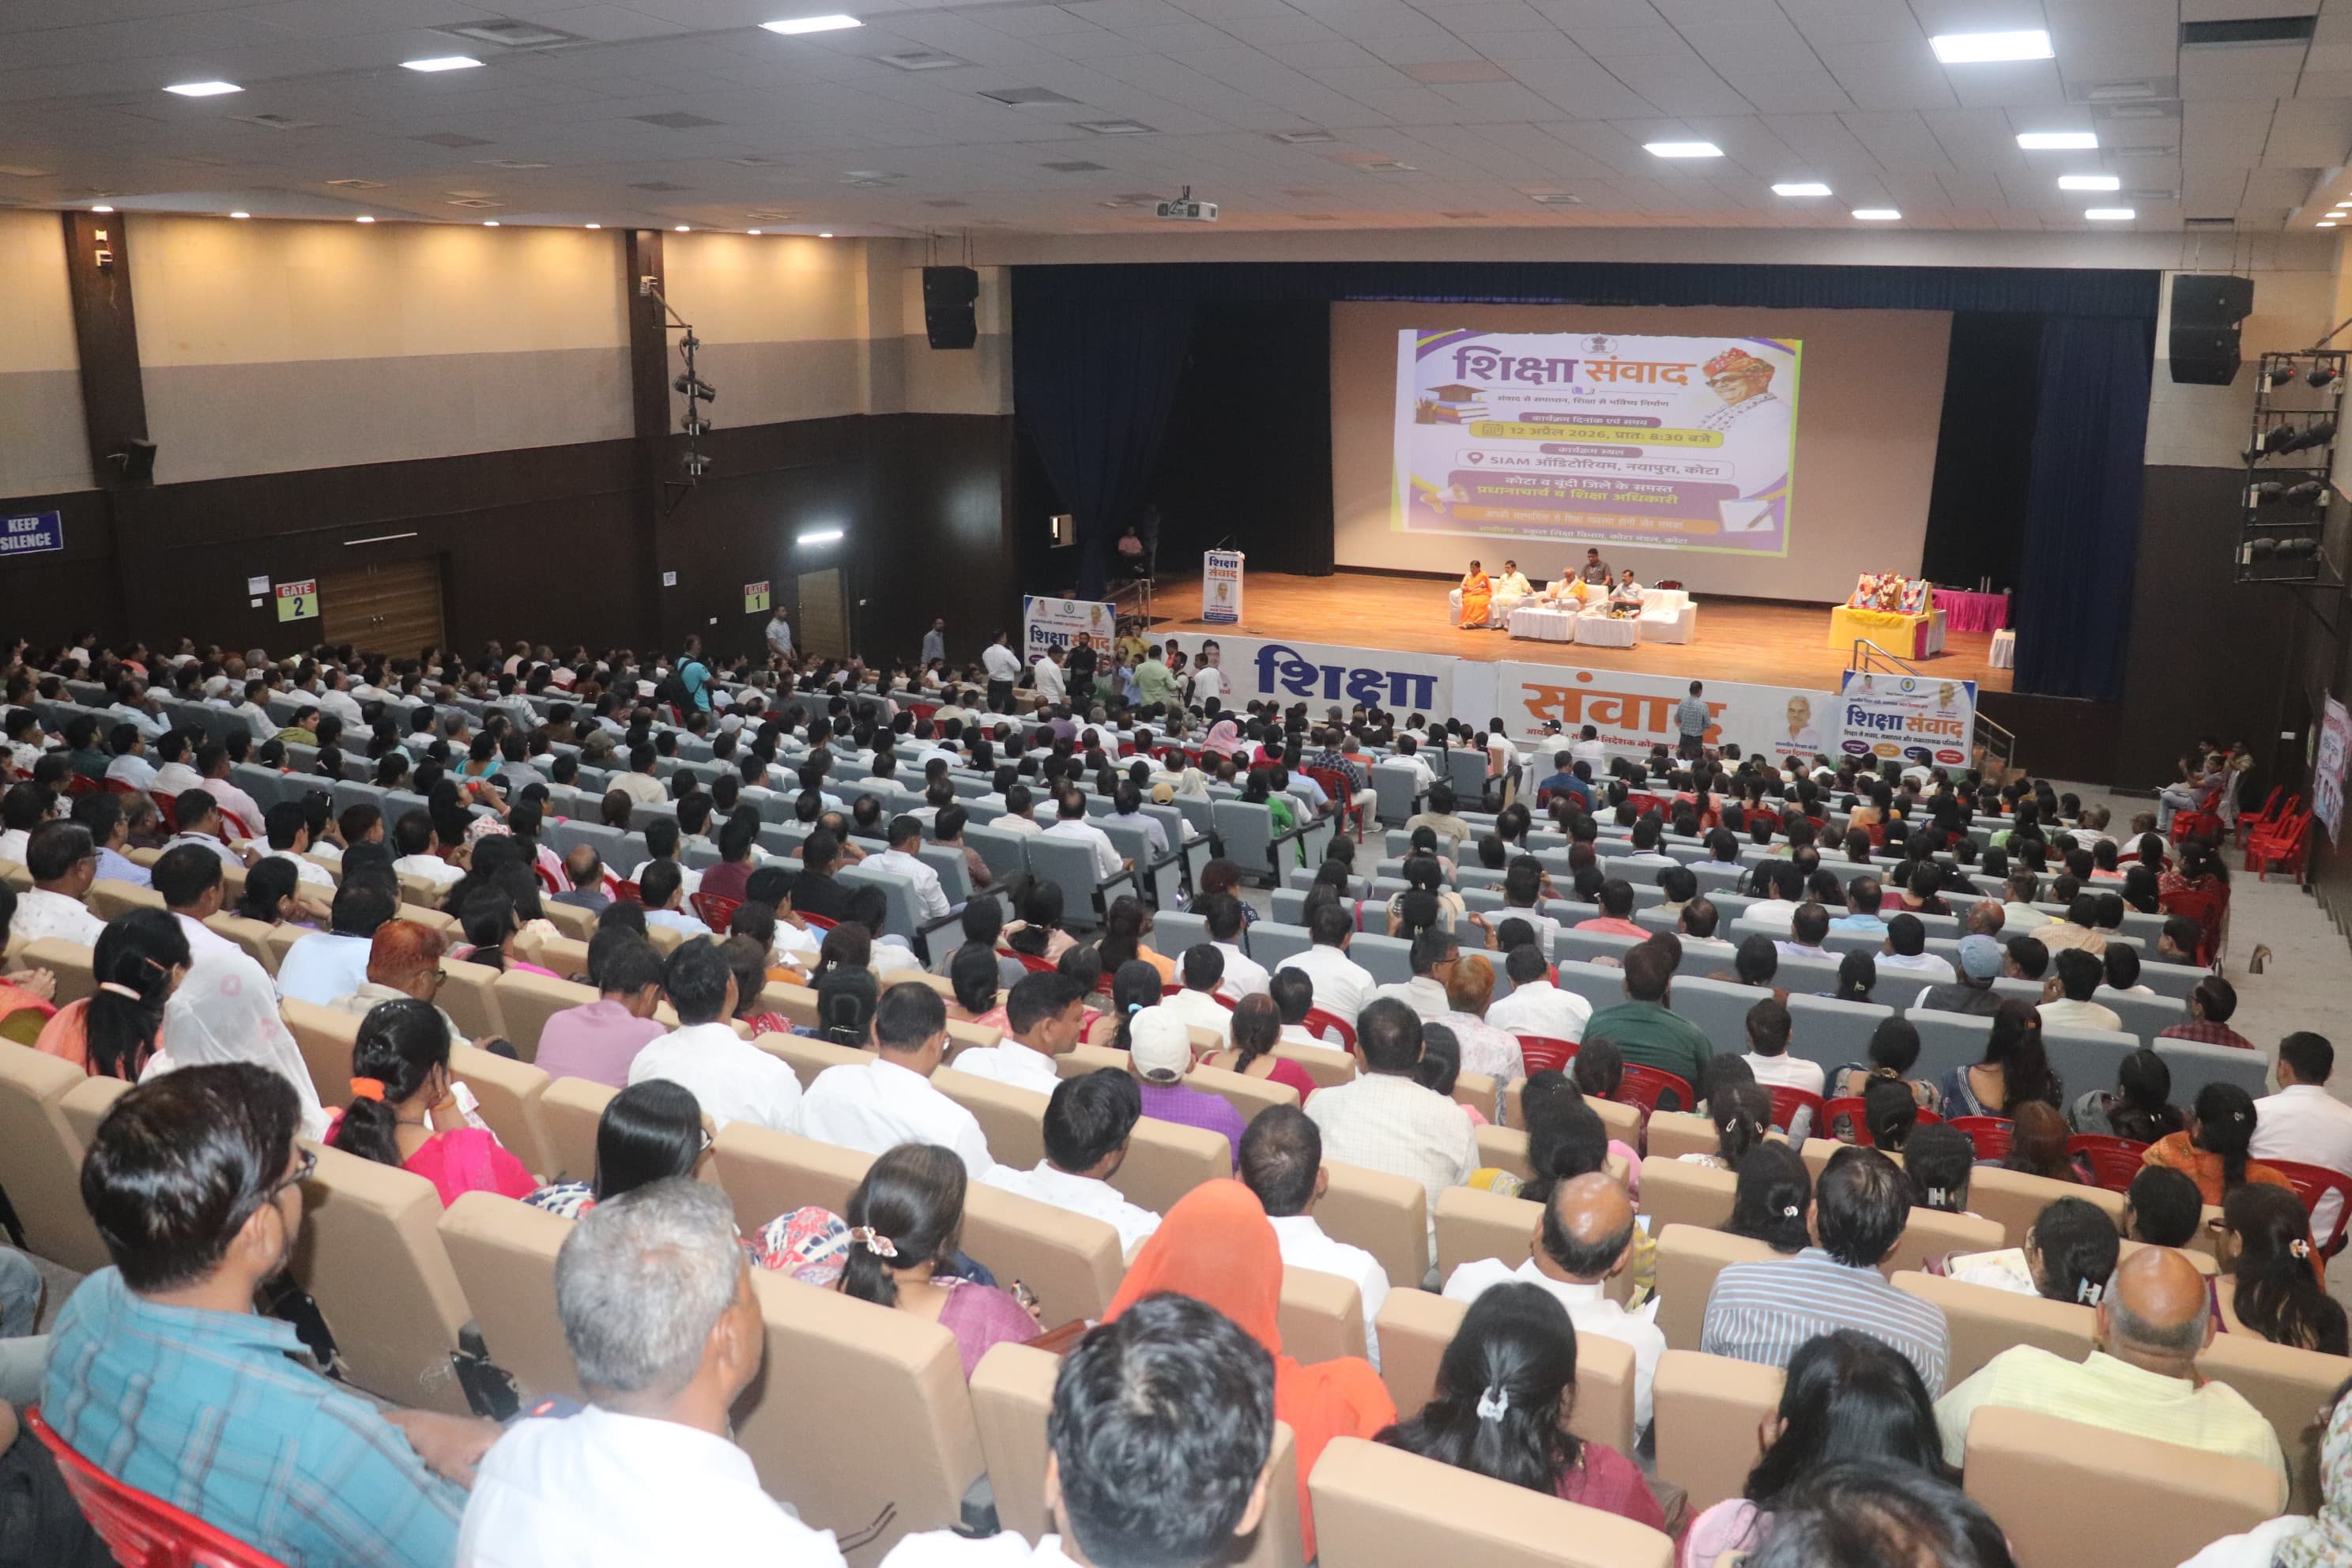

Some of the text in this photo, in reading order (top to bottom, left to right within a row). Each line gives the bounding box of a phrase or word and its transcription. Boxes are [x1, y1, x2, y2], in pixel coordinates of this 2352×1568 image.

[1453, 345, 1698, 386] शिक्षा संवाद
[1640, 398, 1669, 407] निर्माण
[1532, 414, 1570, 424] कार्यक्रम
[1572, 416, 1604, 424] दिनांक
[1607, 416, 1620, 425] एवं
[1529, 425, 1564, 436] अप्रैल
[1569, 429, 1610, 439] 2026,
[1649, 432, 1683, 442] 8:30
[1687, 432, 1711, 443] बजे
[1558, 446, 1597, 454] कार्यक्रम
[1491, 456, 1720, 476] SIAM ऑडिटोरियम, नयापुरा, कोटा
[1504, 475, 1536, 485] कोटा
[1582, 480, 1611, 489] जिले
[1615, 481, 1629, 490] के
[1633, 484, 1674, 492] समस्त
[1476, 485, 1679, 504] प्रधानाचार्य व शिक्षा अधिकारी
[8, 517, 40, 533] KEEP
[0, 533, 51, 550] SILENCE
[1209, 556, 1238, 568] शिक्षा
[1208, 567, 1237, 579] संवाद
[281, 584, 311, 596] GATE
[748, 585, 766, 594] GATE
[293, 597, 304, 616] 2
[755, 594, 760, 609] 1
[1030, 624, 1110, 652] शिक्षा साद
[1253, 644, 1438, 710] शिक्षा
[1846, 704, 1964, 739] शिक्षा संवाद
[1601, 734, 1636, 746] निदेशक
[1638, 739, 1655, 748] को
